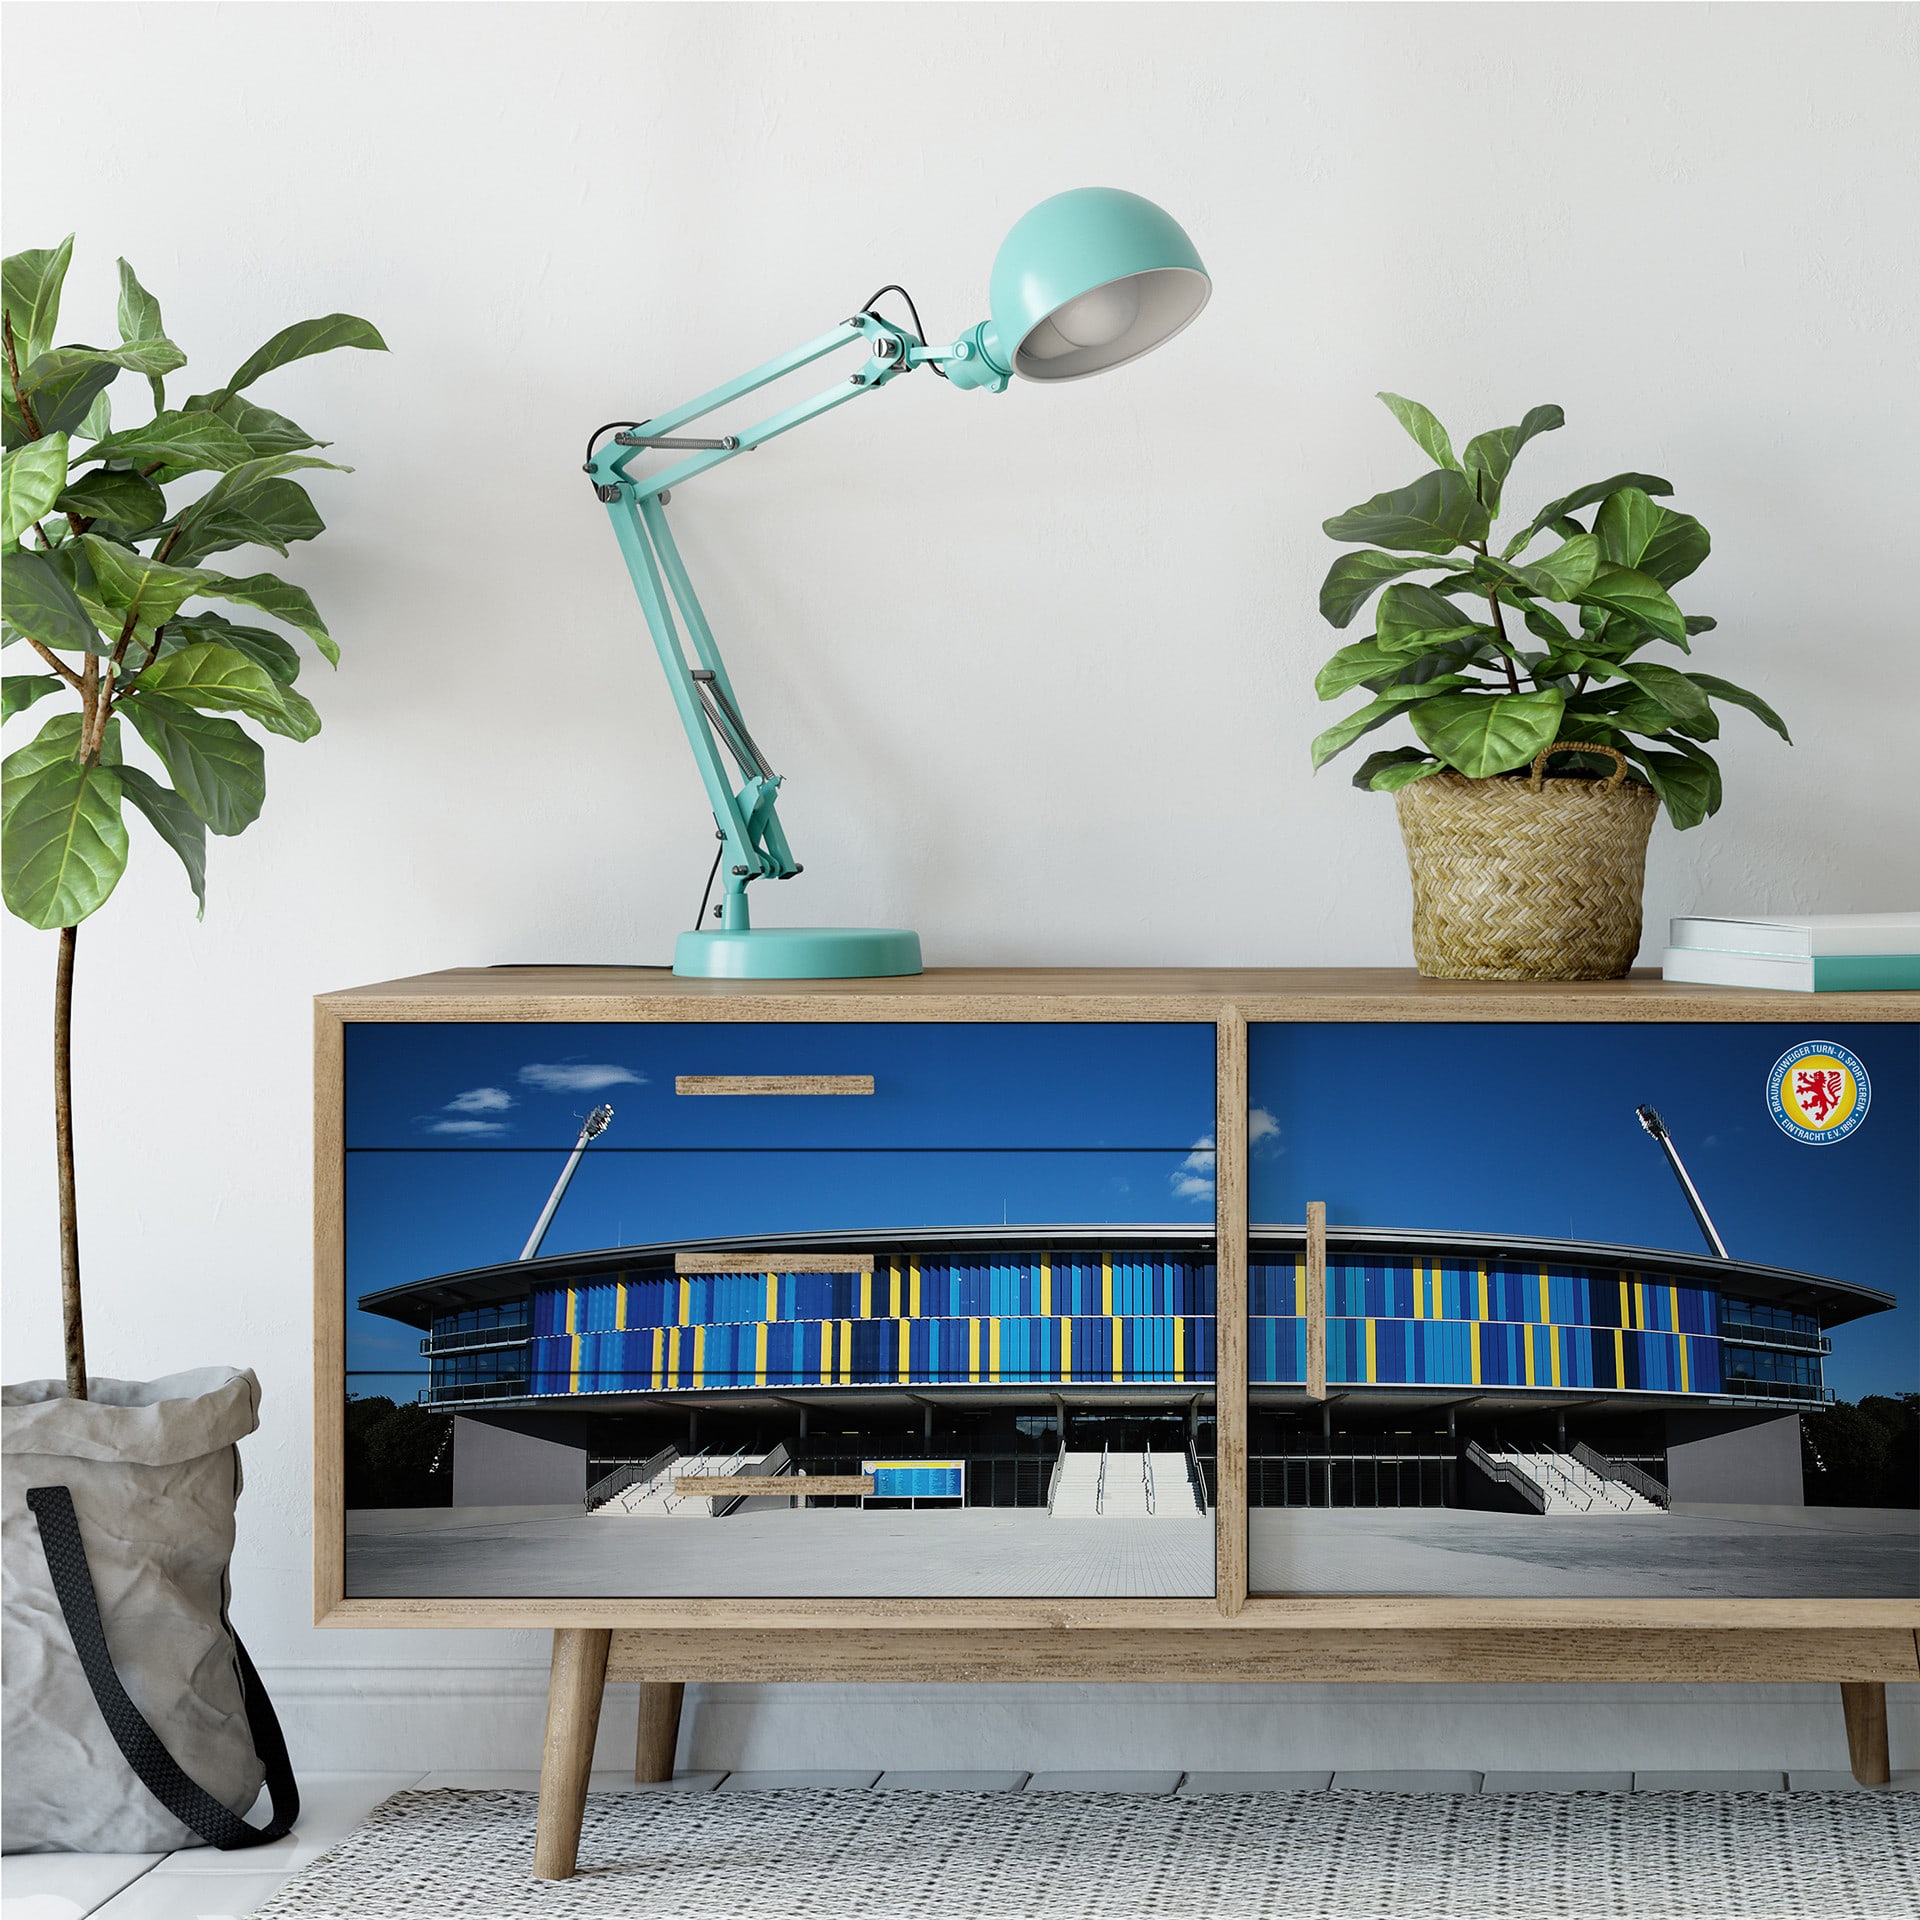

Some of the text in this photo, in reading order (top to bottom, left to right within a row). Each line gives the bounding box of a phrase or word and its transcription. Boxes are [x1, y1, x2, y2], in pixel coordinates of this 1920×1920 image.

[1770, 1046, 1811, 1113] BRAUNSCHWEIGER
[1811, 1044, 1837, 1055] TURN-
[1845, 1057, 1868, 1112] SPORTVEREIN
[1781, 1118, 1826, 1142] EINTRACHT
[1840, 1117, 1857, 1133] 1895
